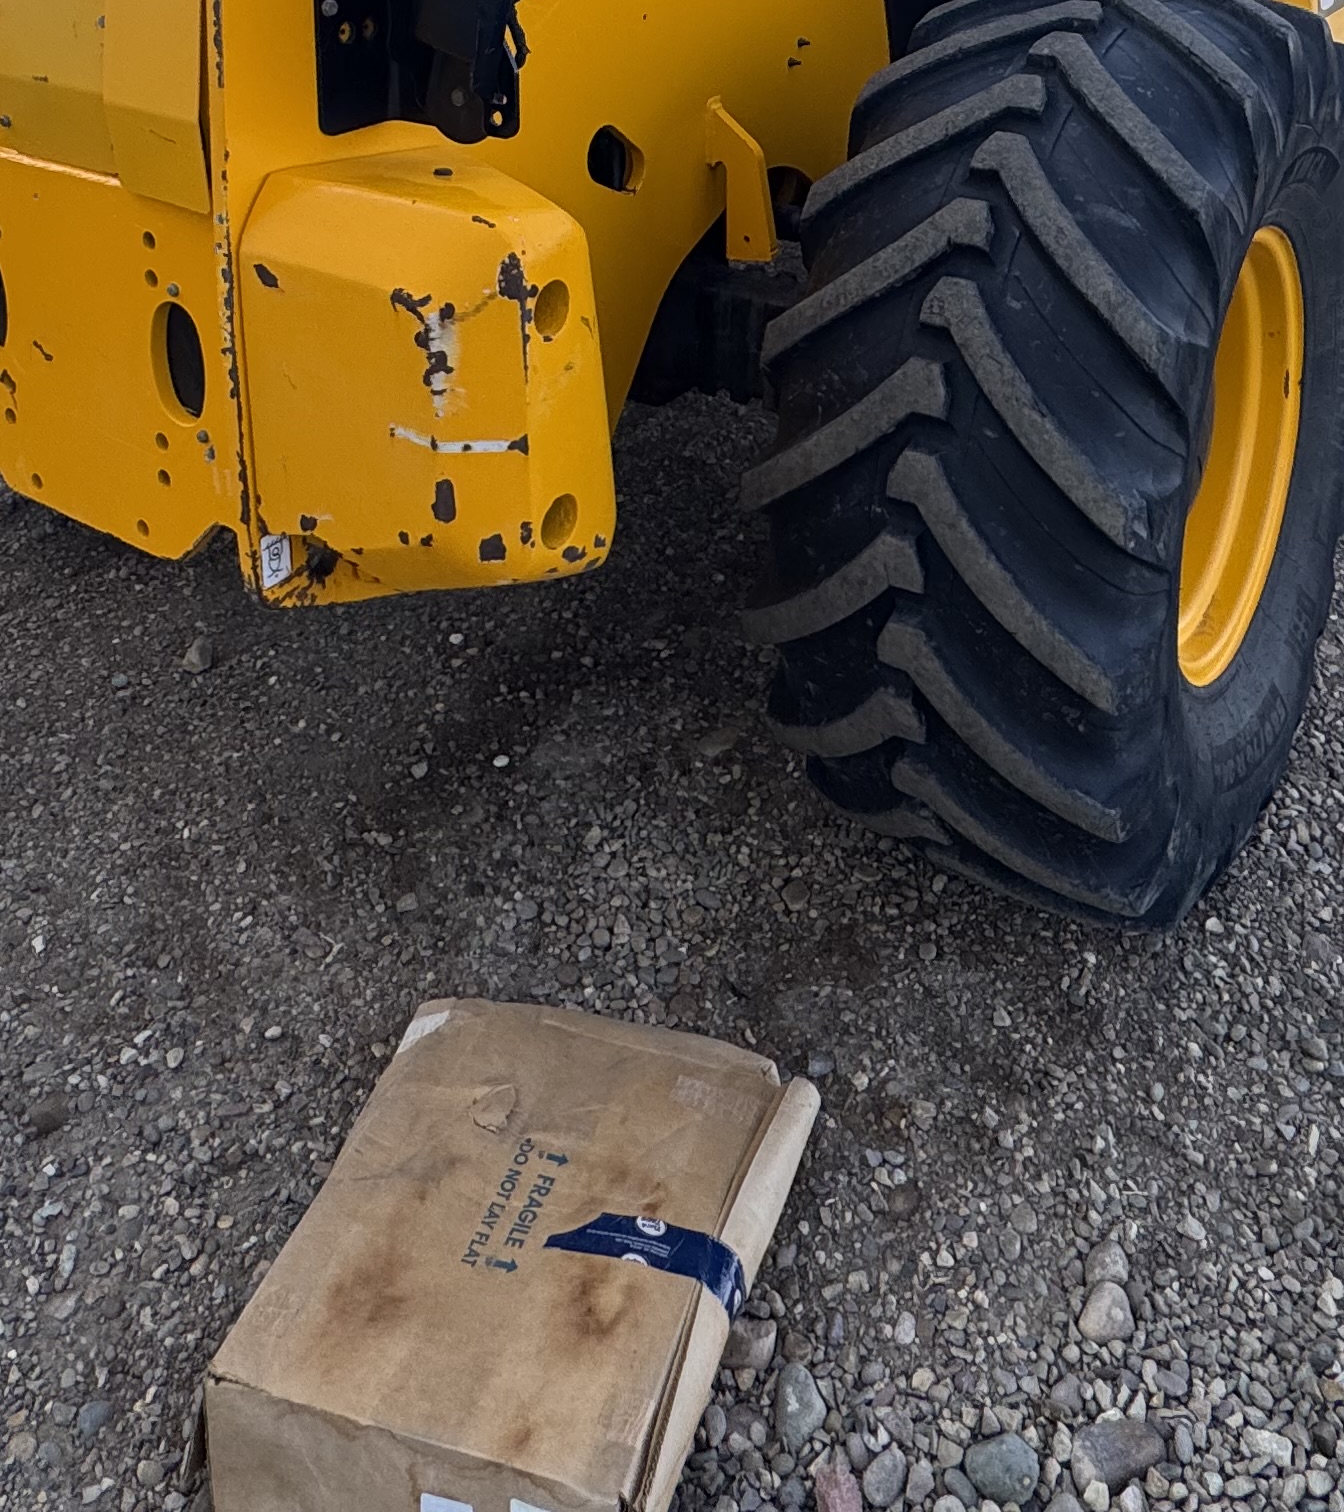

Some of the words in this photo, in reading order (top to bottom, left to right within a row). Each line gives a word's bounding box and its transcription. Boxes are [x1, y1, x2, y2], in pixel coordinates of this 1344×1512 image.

[513, 1142, 535, 1166] DO
[497, 1168, 523, 1201] NOT
[481, 1201, 506, 1231] LAY
[504, 1173, 556, 1249] FRAGILE
[460, 1231, 490, 1268] FLAT
